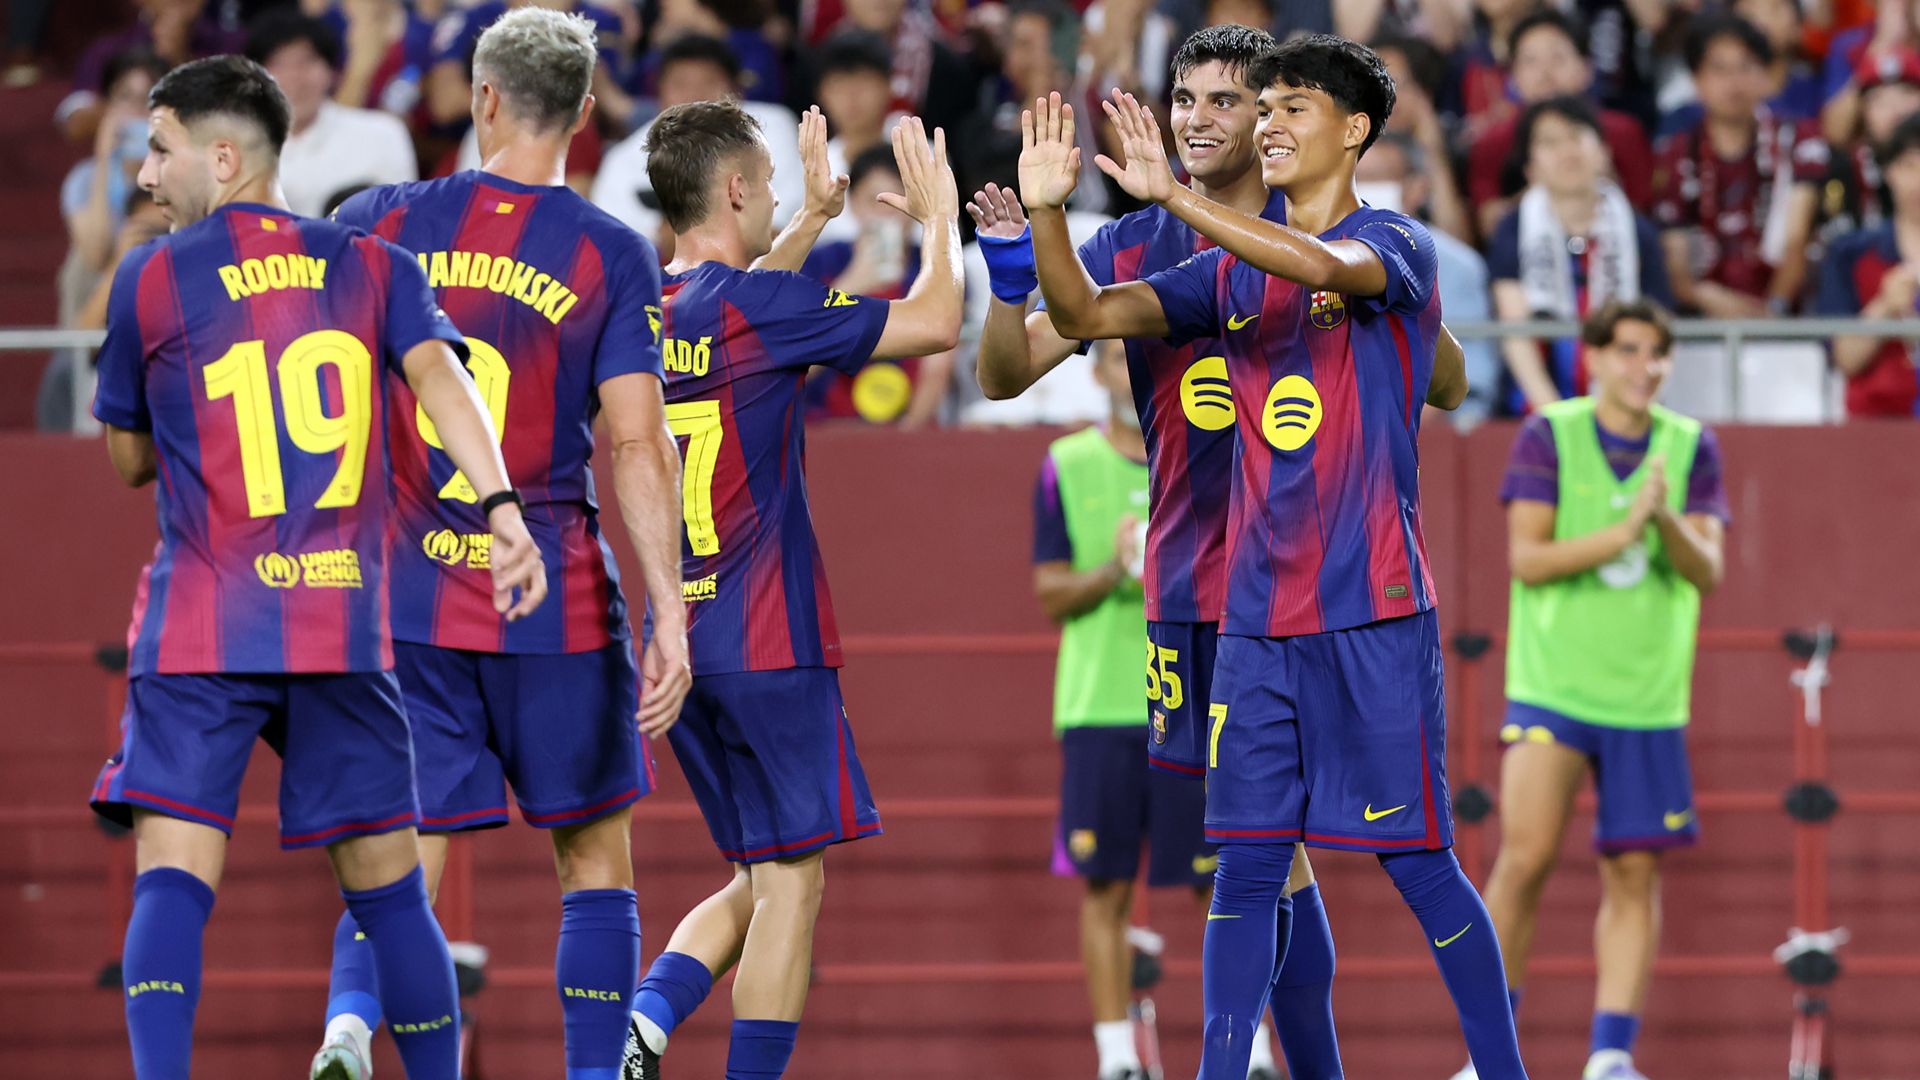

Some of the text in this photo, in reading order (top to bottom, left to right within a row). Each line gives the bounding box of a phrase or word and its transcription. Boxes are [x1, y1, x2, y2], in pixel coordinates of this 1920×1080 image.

[218, 253, 327, 301] ROONY
[203, 330, 371, 518] 19
[681, 579, 717, 597] NUR
[1146, 635, 1184, 710] 35
[1208, 703, 1228, 769] 7
